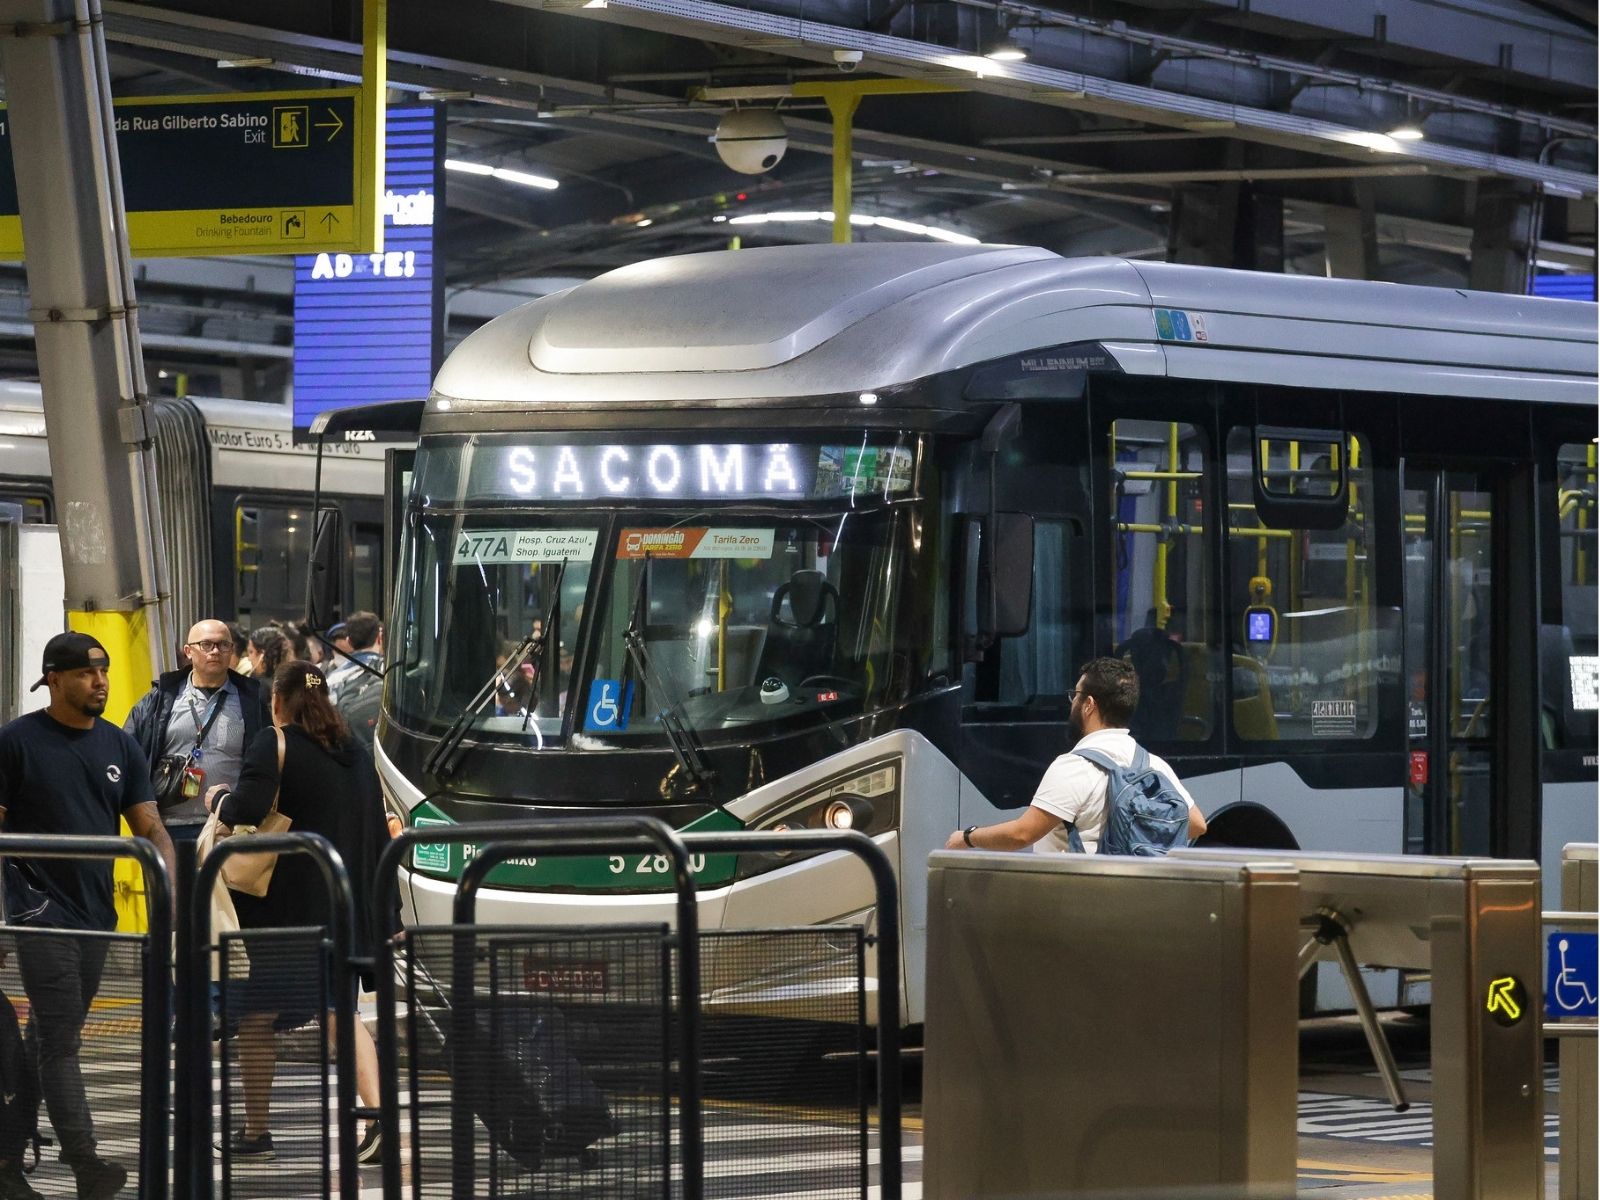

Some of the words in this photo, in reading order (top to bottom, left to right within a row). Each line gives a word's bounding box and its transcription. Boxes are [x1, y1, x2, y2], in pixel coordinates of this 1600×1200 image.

[133, 117, 159, 130] Rua
[162, 115, 217, 130] Gilberto
[220, 113, 268, 127] Sabino
[244, 129, 266, 144] Exit
[220, 214, 273, 224] Bebedouro
[196, 226, 232, 239] Drinking
[234, 226, 272, 237] Fountain
[311, 251, 415, 279] ADTE!
[209, 429, 243, 446] Motor
[244, 431, 273, 449] Euro
[274, 434, 283, 449] 5
[518, 536, 543, 545] Hosp.
[545, 535, 566, 544] Cruz
[567, 535, 588, 544] Azul
[713, 534, 737, 544] Tarifa
[739, 535, 760, 544] Zero
[458, 537, 508, 557] 477A
[543, 548, 581, 557] Iguatemi
[635, 853, 706, 874] 280
